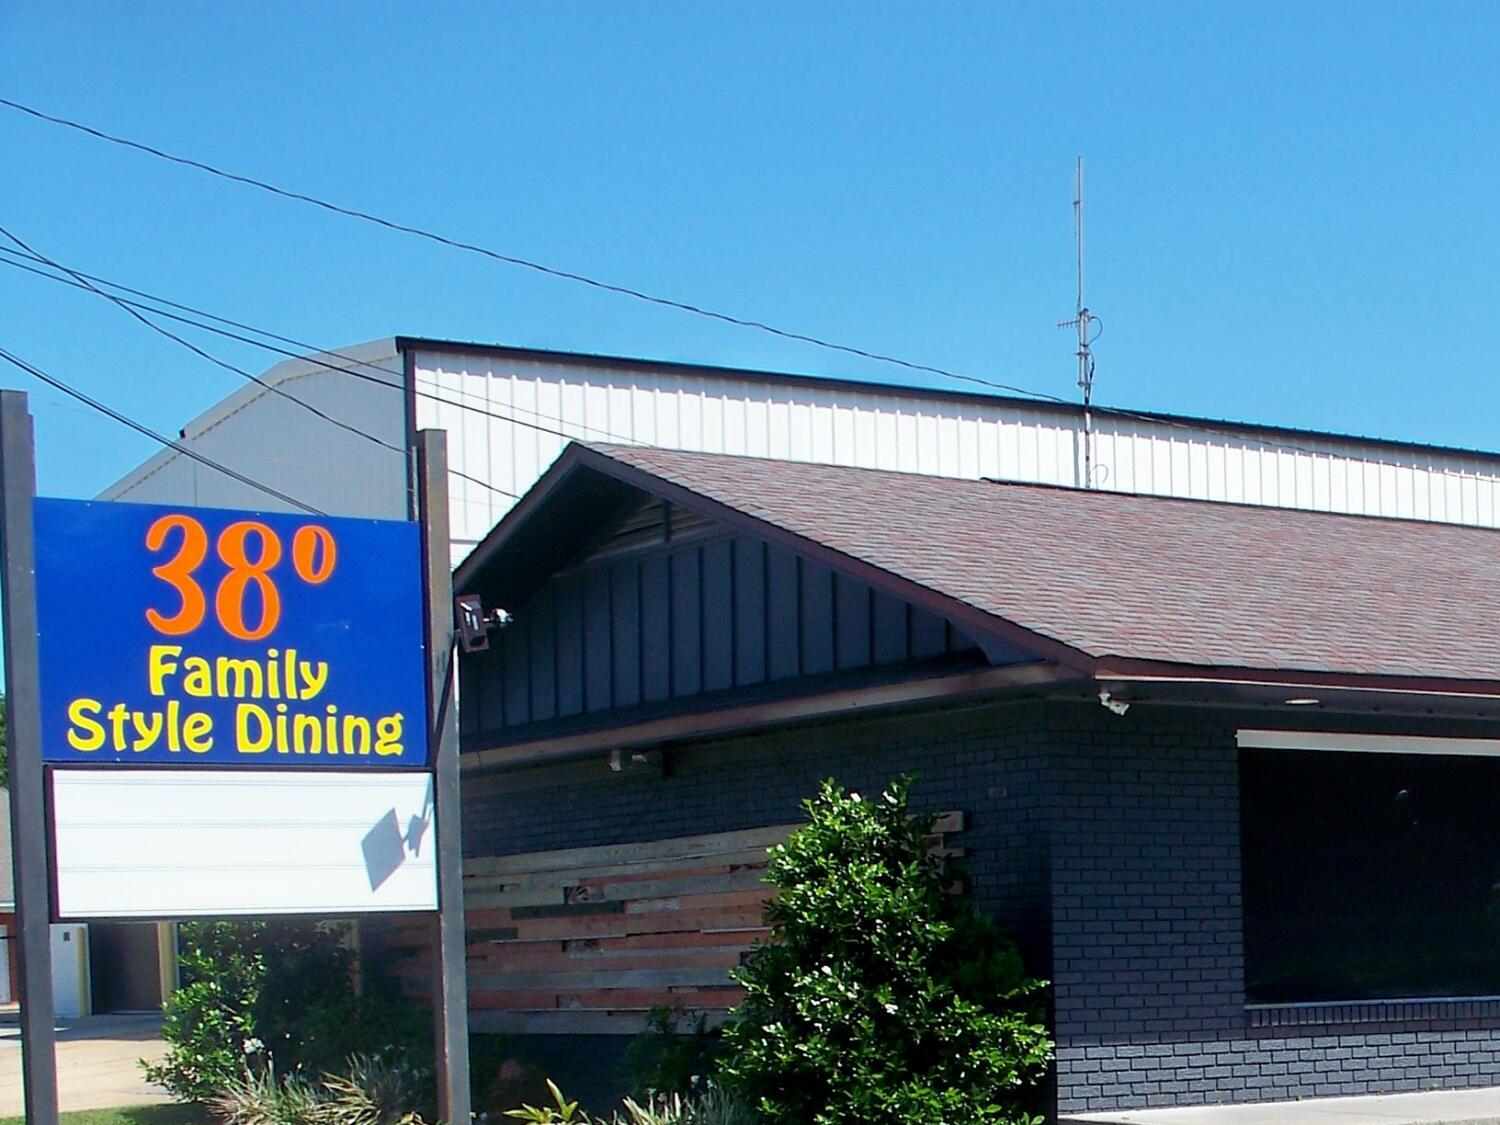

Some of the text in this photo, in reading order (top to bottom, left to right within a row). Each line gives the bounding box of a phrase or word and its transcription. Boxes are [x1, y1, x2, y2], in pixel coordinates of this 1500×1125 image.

[149, 645, 328, 699] Family
[67, 699, 404, 756] Style Dining
